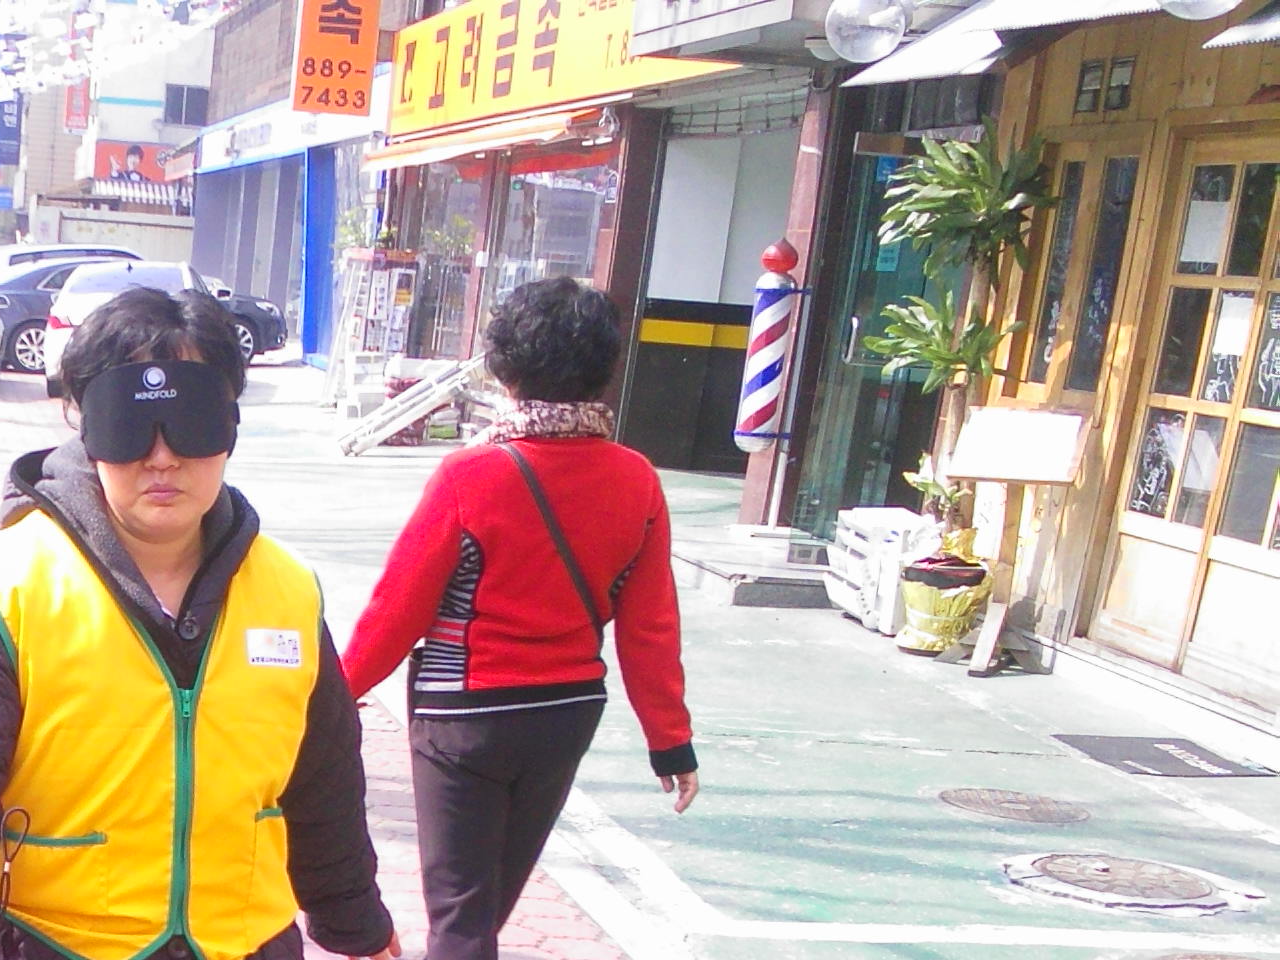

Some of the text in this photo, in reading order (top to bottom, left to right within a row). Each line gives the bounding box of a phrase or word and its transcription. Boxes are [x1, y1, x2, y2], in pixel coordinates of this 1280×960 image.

[429, 0, 561, 109] 고려금속
[303, 57, 367, 79] 889-
[300, 86, 366, 109] 7433
[134, 389, 177, 400] MINDFOLD
